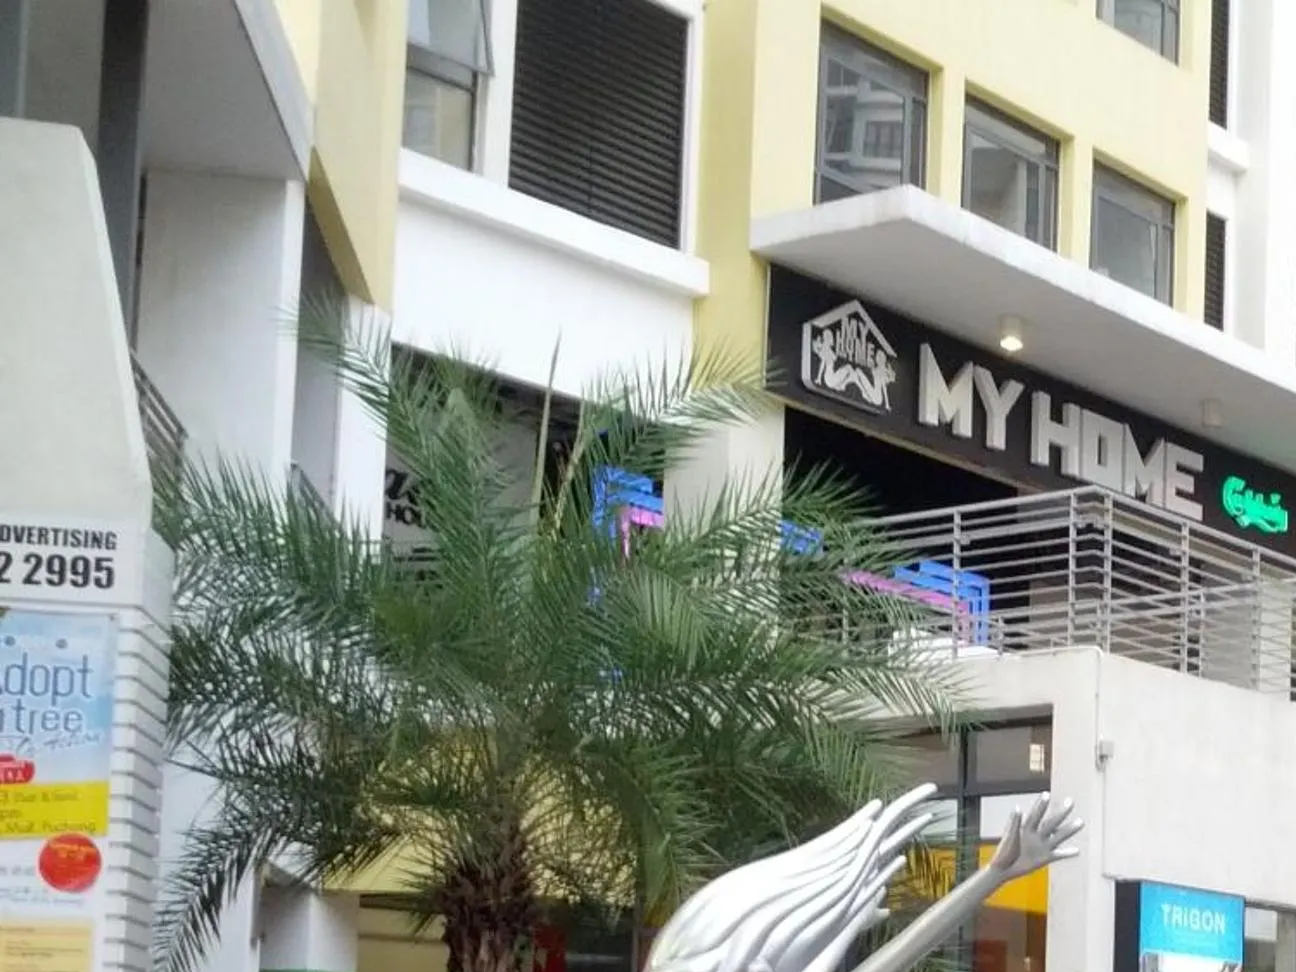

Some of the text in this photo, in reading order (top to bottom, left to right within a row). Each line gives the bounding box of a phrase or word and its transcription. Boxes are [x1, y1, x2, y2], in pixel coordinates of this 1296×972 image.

[918, 342, 1025, 451] MY
[1029, 390, 1204, 522] HOME
[22, 552, 115, 590] 2995
[0, 652, 94, 707] dopt
[1160, 903, 1226, 936] TRIGON
